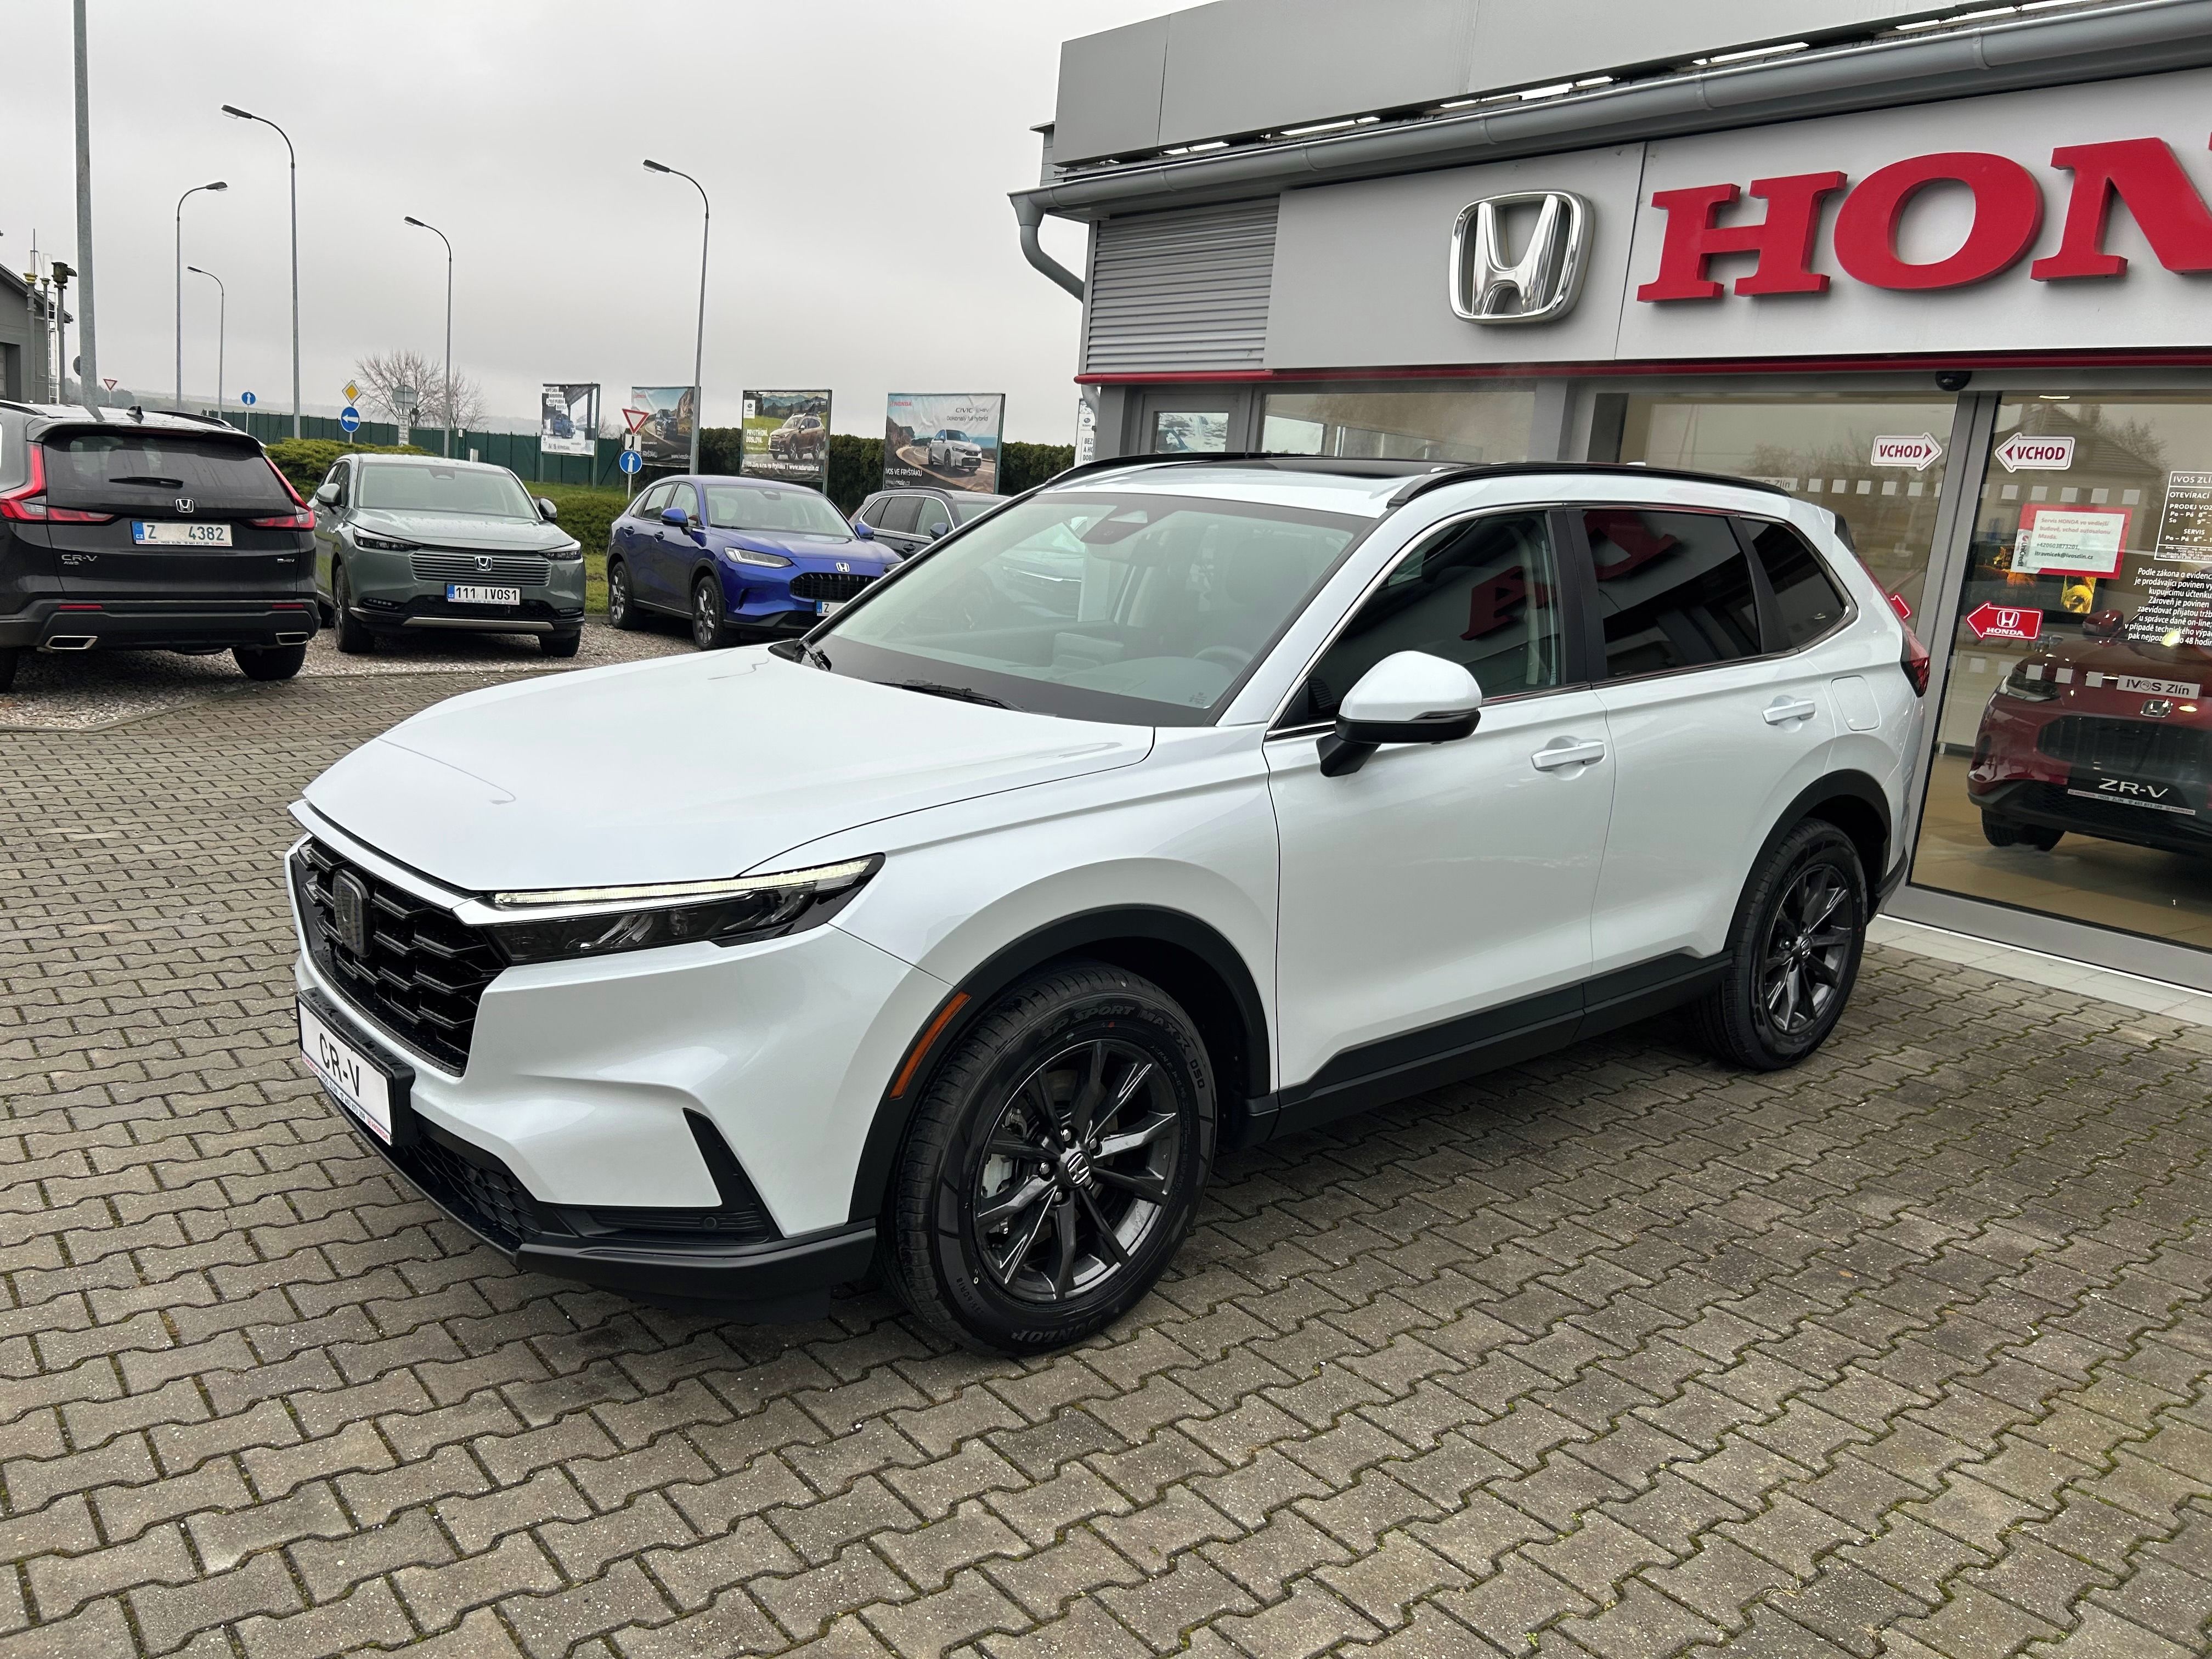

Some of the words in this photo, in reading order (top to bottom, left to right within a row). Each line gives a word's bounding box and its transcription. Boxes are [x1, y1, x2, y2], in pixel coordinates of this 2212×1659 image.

[1880, 444, 1922, 458] VCHOD
[2017, 446, 2066, 460] VCHOD
[900, 467, 923, 477] FRYŠTÁKU
[2197, 475, 2212, 483] ZLÍ
[2170, 491, 2210, 499] OTEVÍRACÍ
[147, 524, 156, 539] Z
[189, 526, 224, 541] 4382
[2017, 542, 2028, 566] UniCredit
[2137, 567, 2155, 576] Podle
[2157, 569, 2180, 578] zákona
[2134, 577, 2140, 585] je
[2142, 578, 2177, 588] prodávající
[2177, 580, 2204, 589] povinen
[456, 587, 475, 599] 111
[485, 588, 517, 601] IVOS1
[2148, 587, 2184, 597] kupujícímu
[824, 603, 830, 613] Z
[2148, 596, 2174, 605] Zároveň
[2175, 599, 2181, 607] je
[2182, 600, 2209, 608] povinen
[2137, 606, 2171, 614] zaevidovat
[2172, 607, 2198, 617] přijatou
[2144, 615, 2169, 624] správce
[2170, 616, 2186, 625] daně
[1986, 627, 2025, 636] HONDA
[2129, 622, 2154, 631] případě
[2155, 624, 2194, 635] technického
[2196, 628, 2212, 638] výpa
[2126, 679, 2162, 691] IVOS
[2165, 684, 2190, 695] Zlín
[2099, 778, 2168, 798] ZR-V
[1071, 1004, 1136, 1023] SPORT
[1137, 1009, 1191, 1053] MAXX
[320, 1032, 359, 1097] CR-V
[371, 1122, 389, 1141] HONDA
